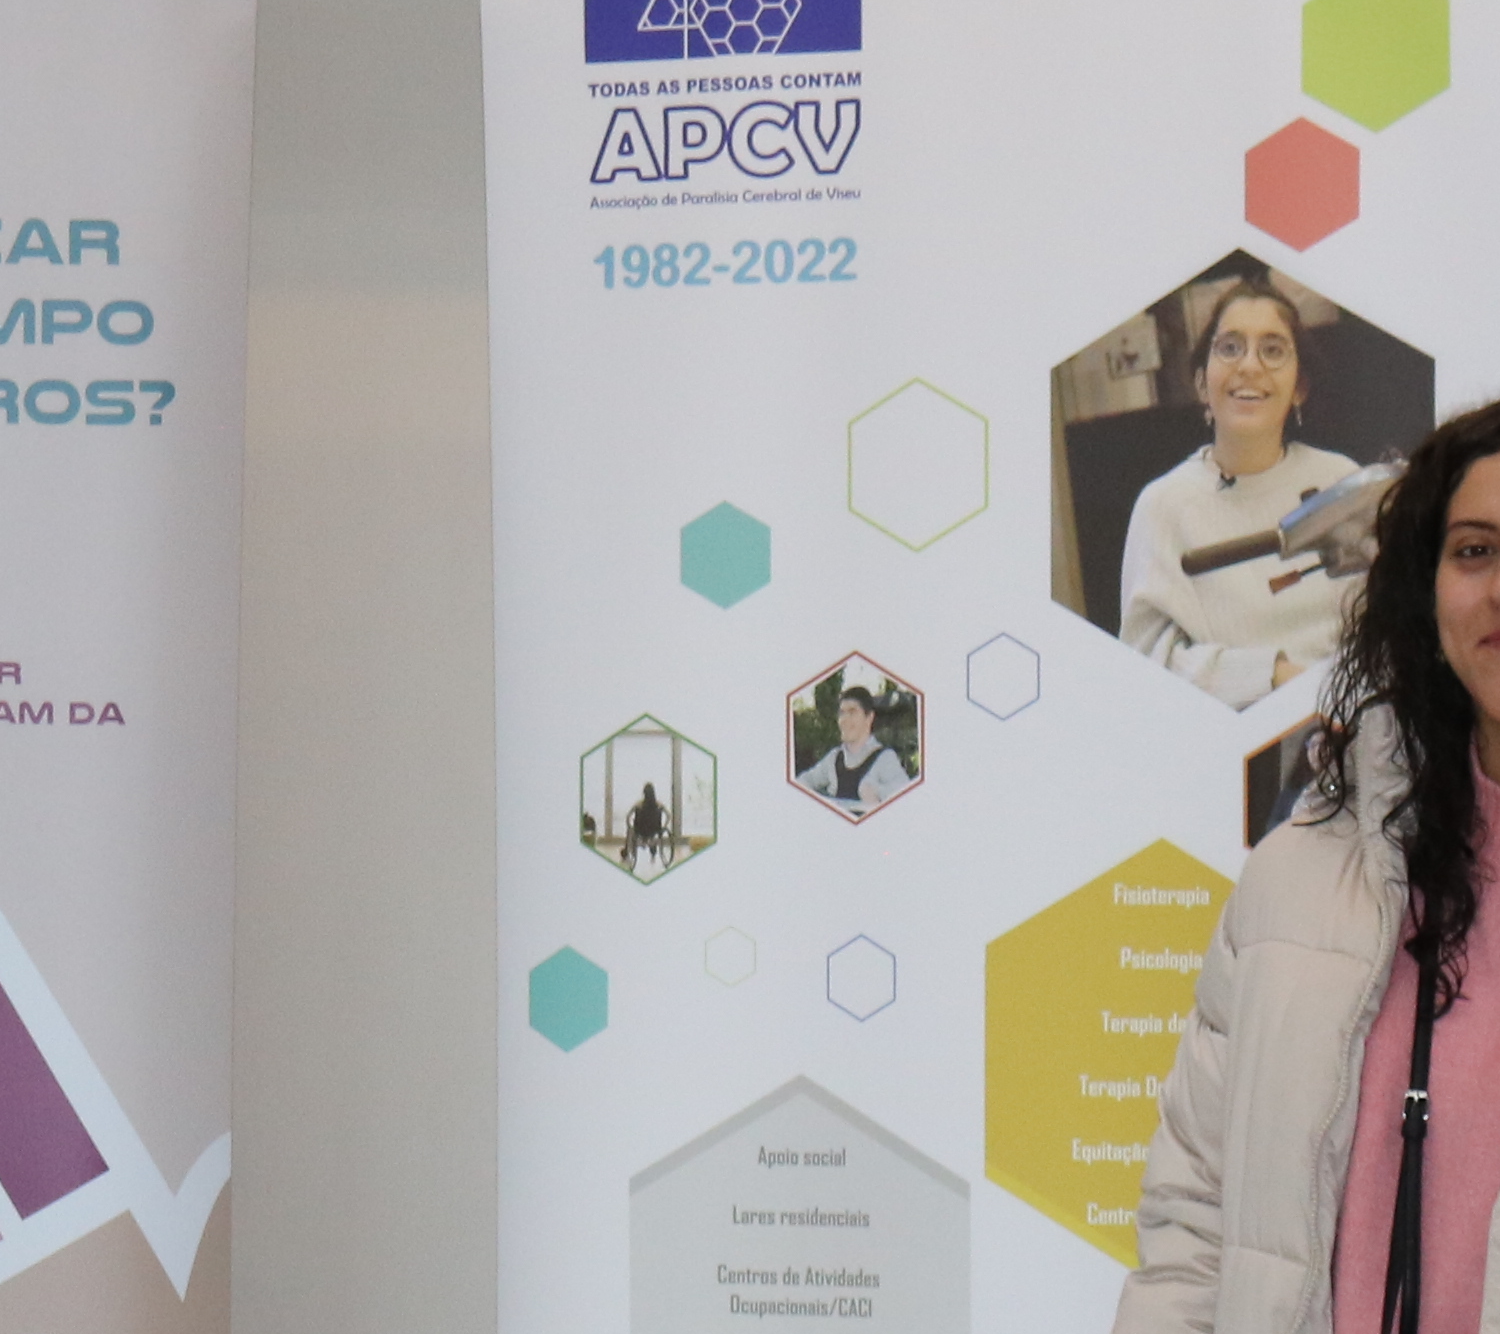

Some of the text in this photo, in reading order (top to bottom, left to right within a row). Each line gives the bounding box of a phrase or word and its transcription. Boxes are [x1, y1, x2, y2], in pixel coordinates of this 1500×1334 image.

[588, 71, 861, 97] TODAS AS PESSOAS CONTAM
[590, 98, 861, 184] APCV
[590, 187, 861, 210] Associação de Paralisia Cerebral de Viseu
[593, 237, 857, 290] 1982-2022
[69, 702, 125, 725] DA
[1113, 882, 1210, 908] Fisioterapia
[1120, 948, 1203, 973] Psicologia
[1101, 1010, 1164, 1037] Terapia
[1079, 1074, 1142, 1101] Terapia
[758, 1146, 846, 1169] Apoio social
[732, 1205, 870, 1228] Lares residenciais
[1087, 1202, 1140, 1230] Centr
[717, 1264, 880, 1288] Centros de Atividades
[730, 1294, 872, 1318] Ocupacionais/CACI
